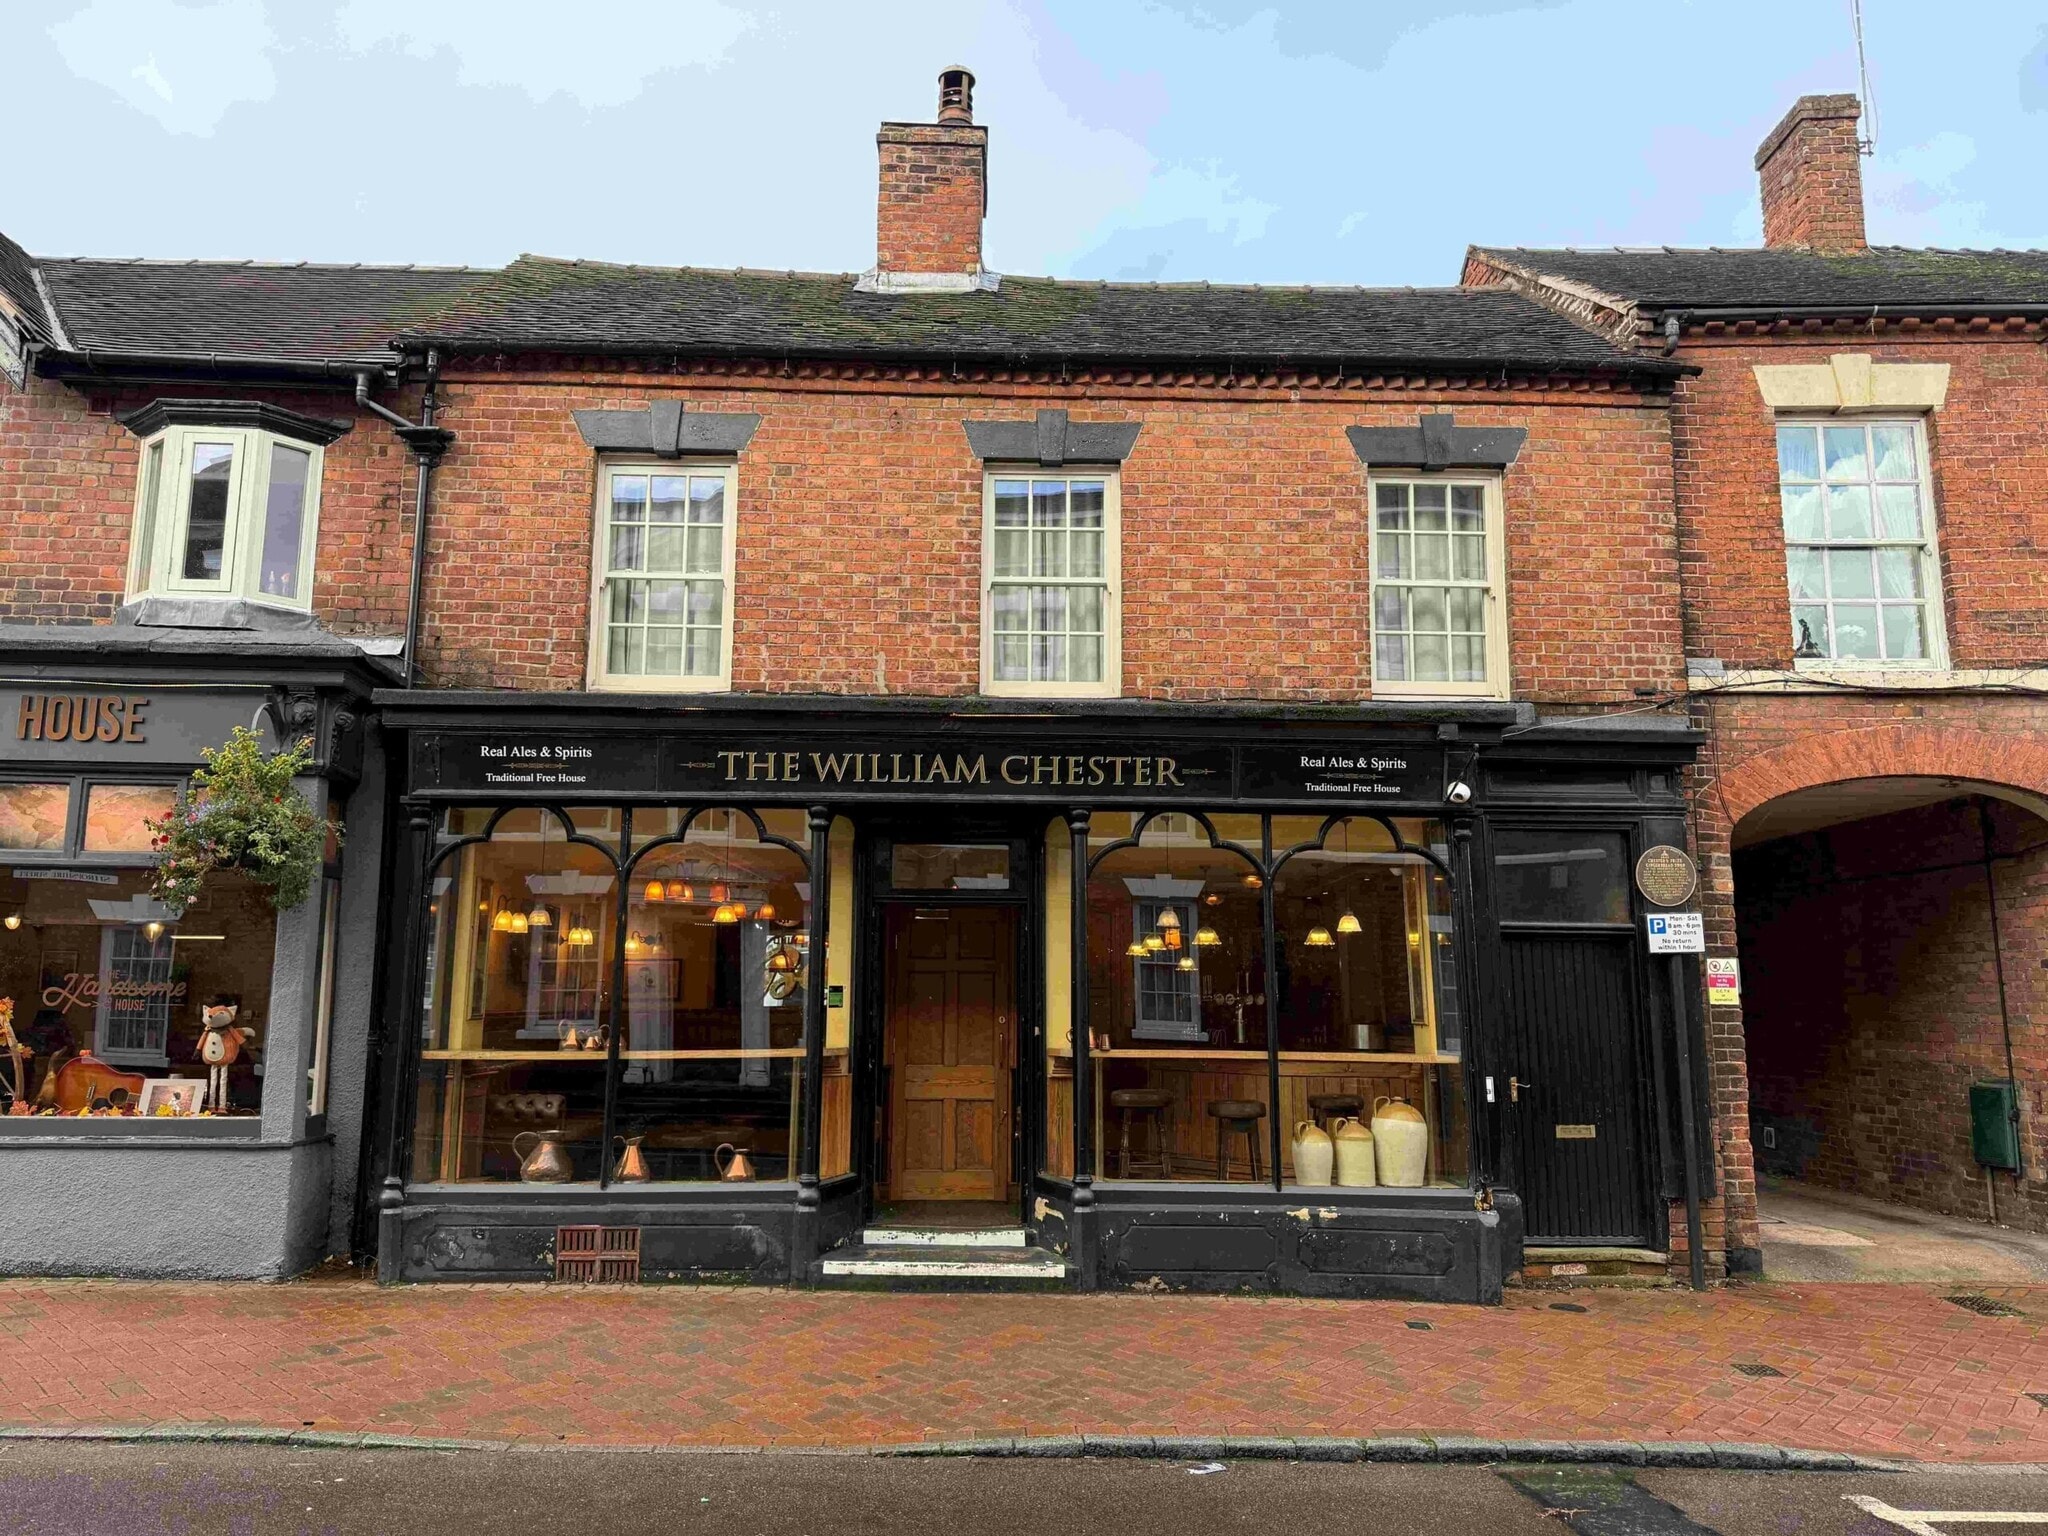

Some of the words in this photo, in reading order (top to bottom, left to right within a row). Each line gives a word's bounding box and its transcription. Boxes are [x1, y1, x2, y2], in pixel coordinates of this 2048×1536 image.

[16, 694, 149, 742] HOUSE
[480, 745, 507, 758] Real
[510, 745, 537, 758] Ales
[540, 746, 552, 758] &
[554, 746, 592, 761] Spirits
[717, 751, 800, 781] THE
[808, 752, 991, 784] WILLIAM
[1000, 755, 1185, 786] CHESTER
[1300, 756, 1326, 768] Real
[1328, 756, 1354, 768] Ales
[1356, 757, 1368, 768] &
[1370, 757, 1407, 771] Spirits
[485, 772, 534, 783] Traditional
[536, 773, 556, 783] Free
[558, 773, 586, 783] House
[1304, 782, 1351, 792] Traditional
[1353, 783, 1372, 793] Free
[1373, 783, 1401, 794] House
[1653, 919, 1664, 933] P
[114, 998, 145, 1011] HOUSE
